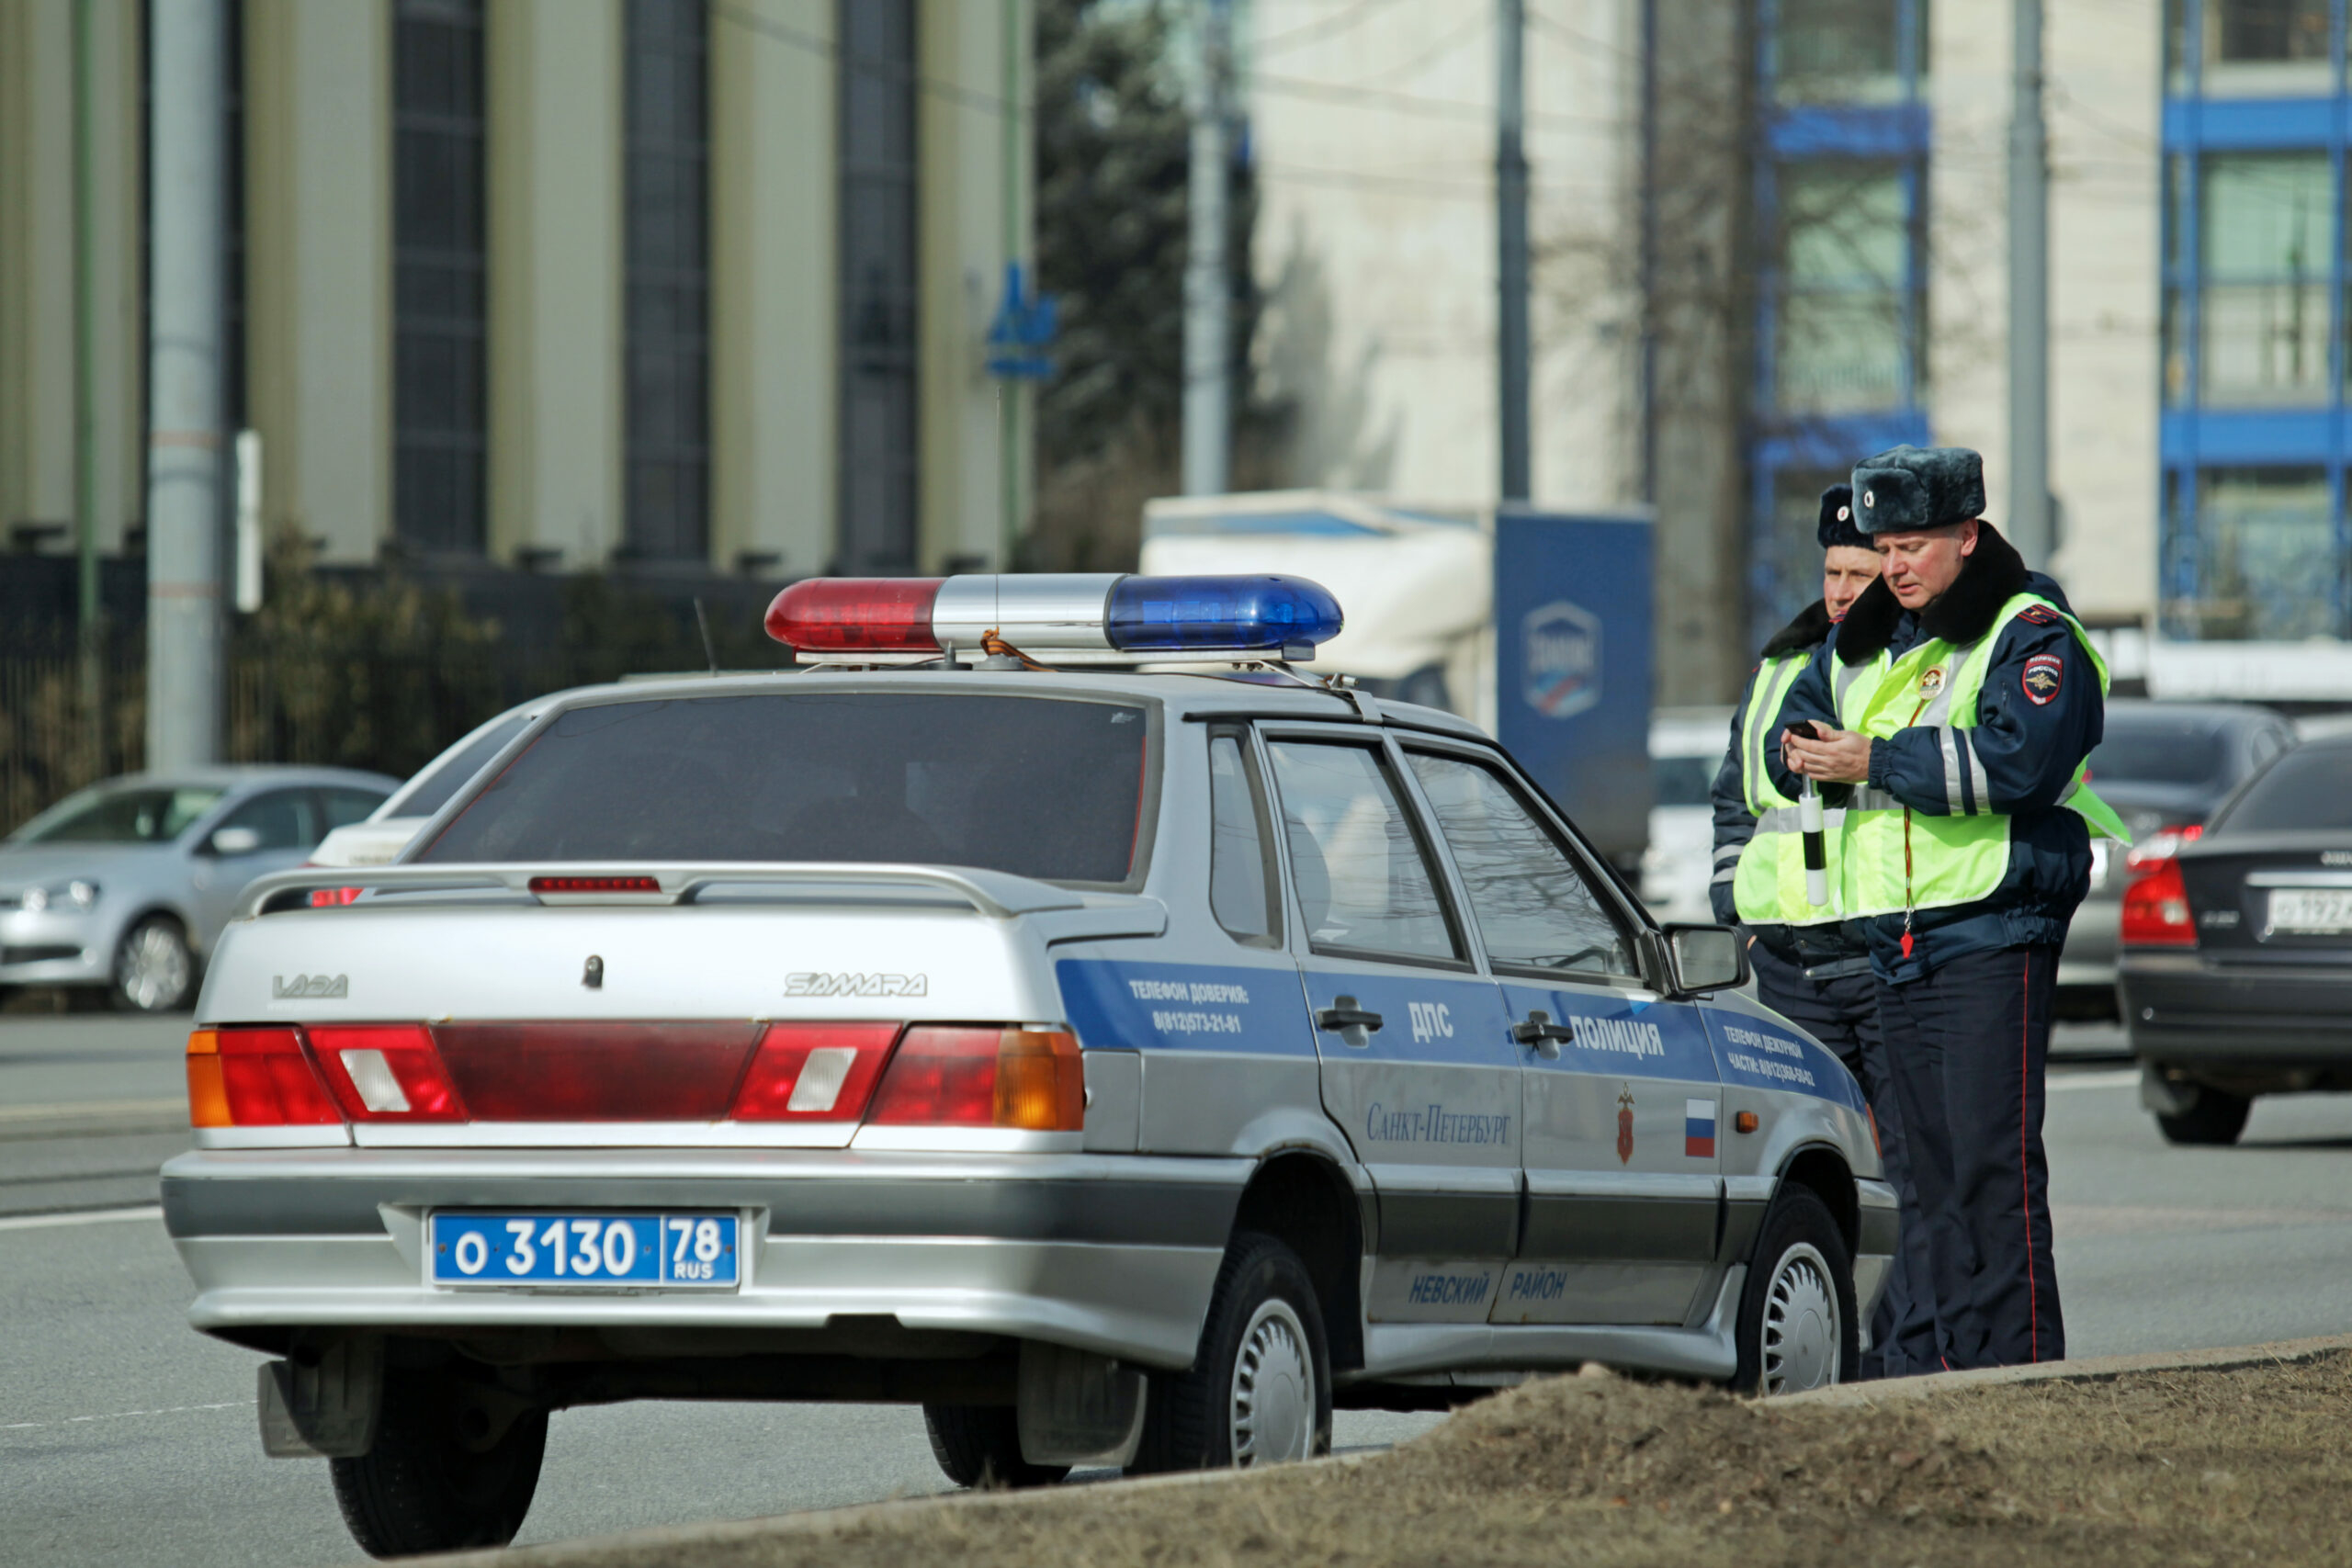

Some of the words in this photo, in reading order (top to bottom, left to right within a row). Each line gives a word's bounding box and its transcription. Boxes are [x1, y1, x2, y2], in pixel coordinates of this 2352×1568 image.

[2028, 665, 2059, 677] РОССИЯ
[272, 974, 348, 999] LADA
[783, 972, 928, 998] SAMARA
[1128, 979, 1190, 1001] ТЕЛЕФОН
[1190, 983, 1250, 1005] ДОВЕРИЯ:
[1152, 1010, 1241, 1035] 8(812)573-21-81
[1408, 1002, 1453, 1043] ДПС
[1569, 1015, 1665, 1061] ПОЛИЦИЯ
[1723, 1025, 1764, 1049] ТЕЛЕФОН
[1761, 1034, 1804, 1060] ДЕЖУРНОЙ
[1727, 1053, 1759, 1074] ЧАСТИ:
[668, 1219, 721, 1263] 78
[674, 1263, 713, 1280] RUS
[1408, 1271, 1490, 1304] НЕВСКИЙ
[1509, 1264, 1568, 1301] РАЙОН
